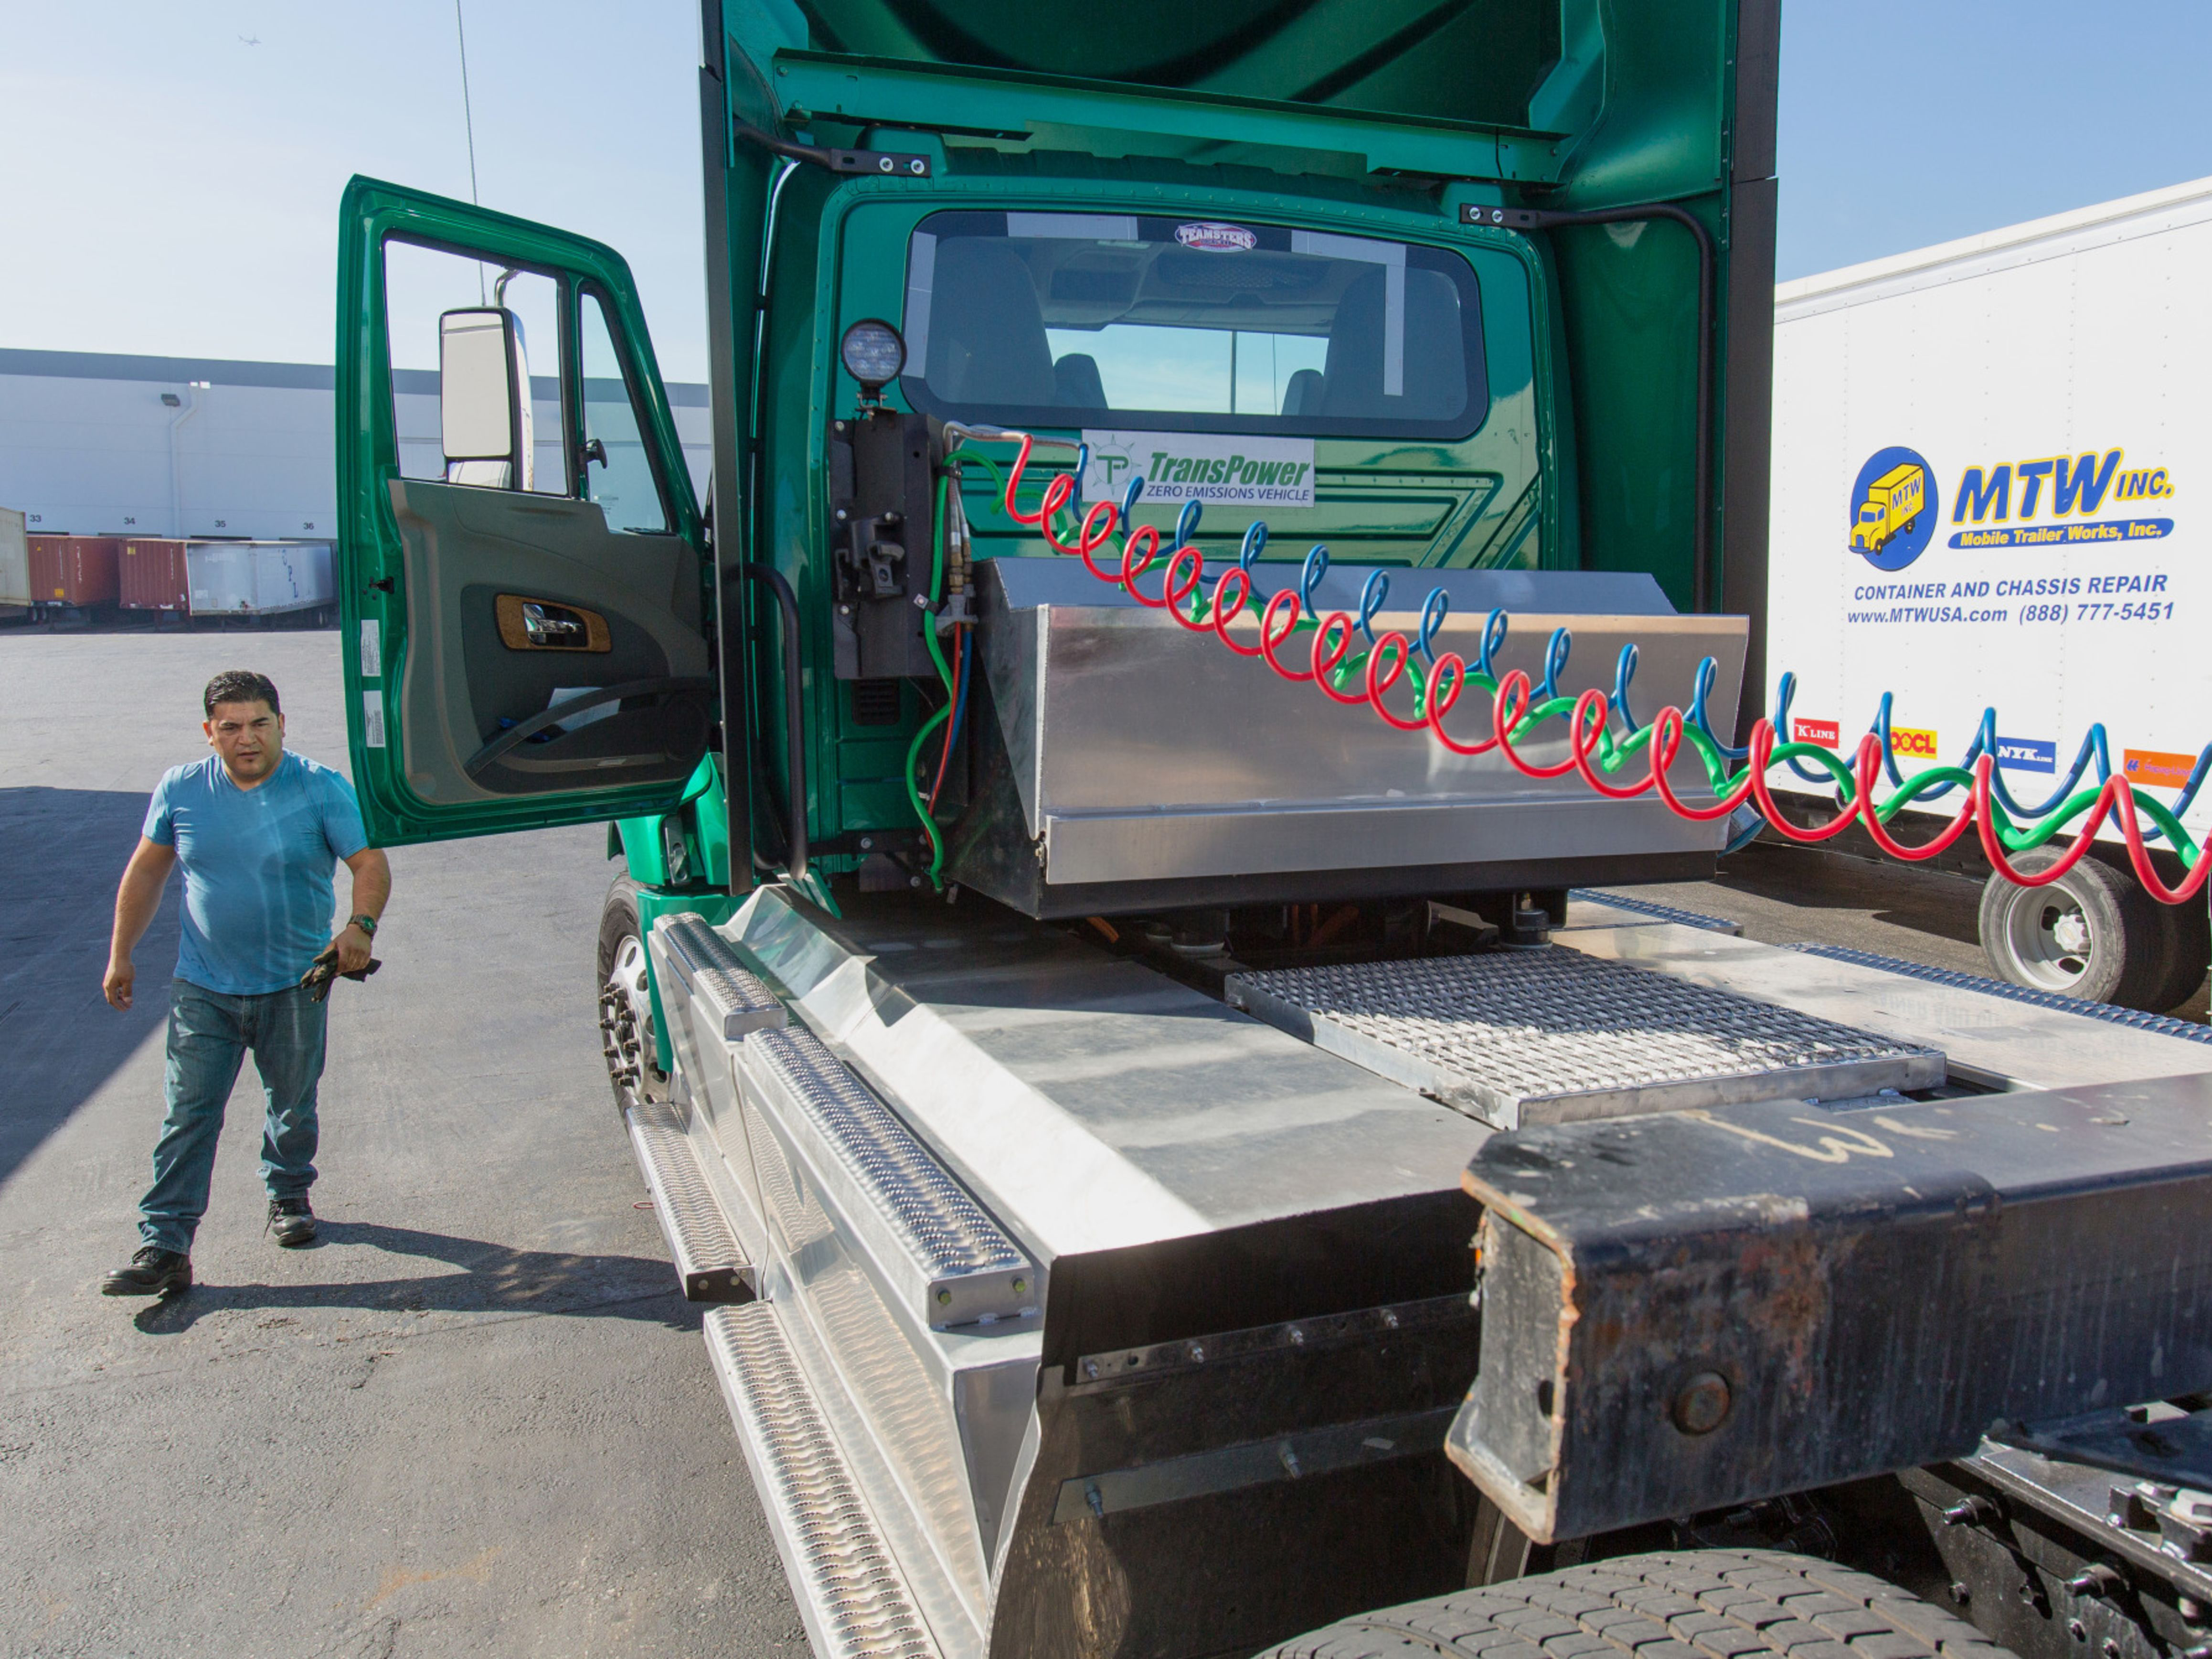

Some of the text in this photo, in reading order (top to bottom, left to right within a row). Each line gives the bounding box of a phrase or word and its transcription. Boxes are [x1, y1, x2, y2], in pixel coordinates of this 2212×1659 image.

[1179, 225, 1253, 250] TEAMSTERS
[1148, 452, 1310, 486] TransPower
[1147, 485, 1310, 500] ZERO EMISSIONS VEHICLE
[1892, 476, 1921, 510] MTW
[1952, 448, 2174, 524] MTW INC.
[29, 514, 42, 522] 33
[1960, 522, 2162, 546] Mobile Trailer Works, Inc.
[1854, 574, 2168, 600] CONTAINER AND CHASSIS REPAIR
[1848, 602, 2174, 626] www.MTWUSA.com (888) 777-5451
[1795, 724, 1836, 740] K LINE
[1997, 745, 2038, 760] NYK
